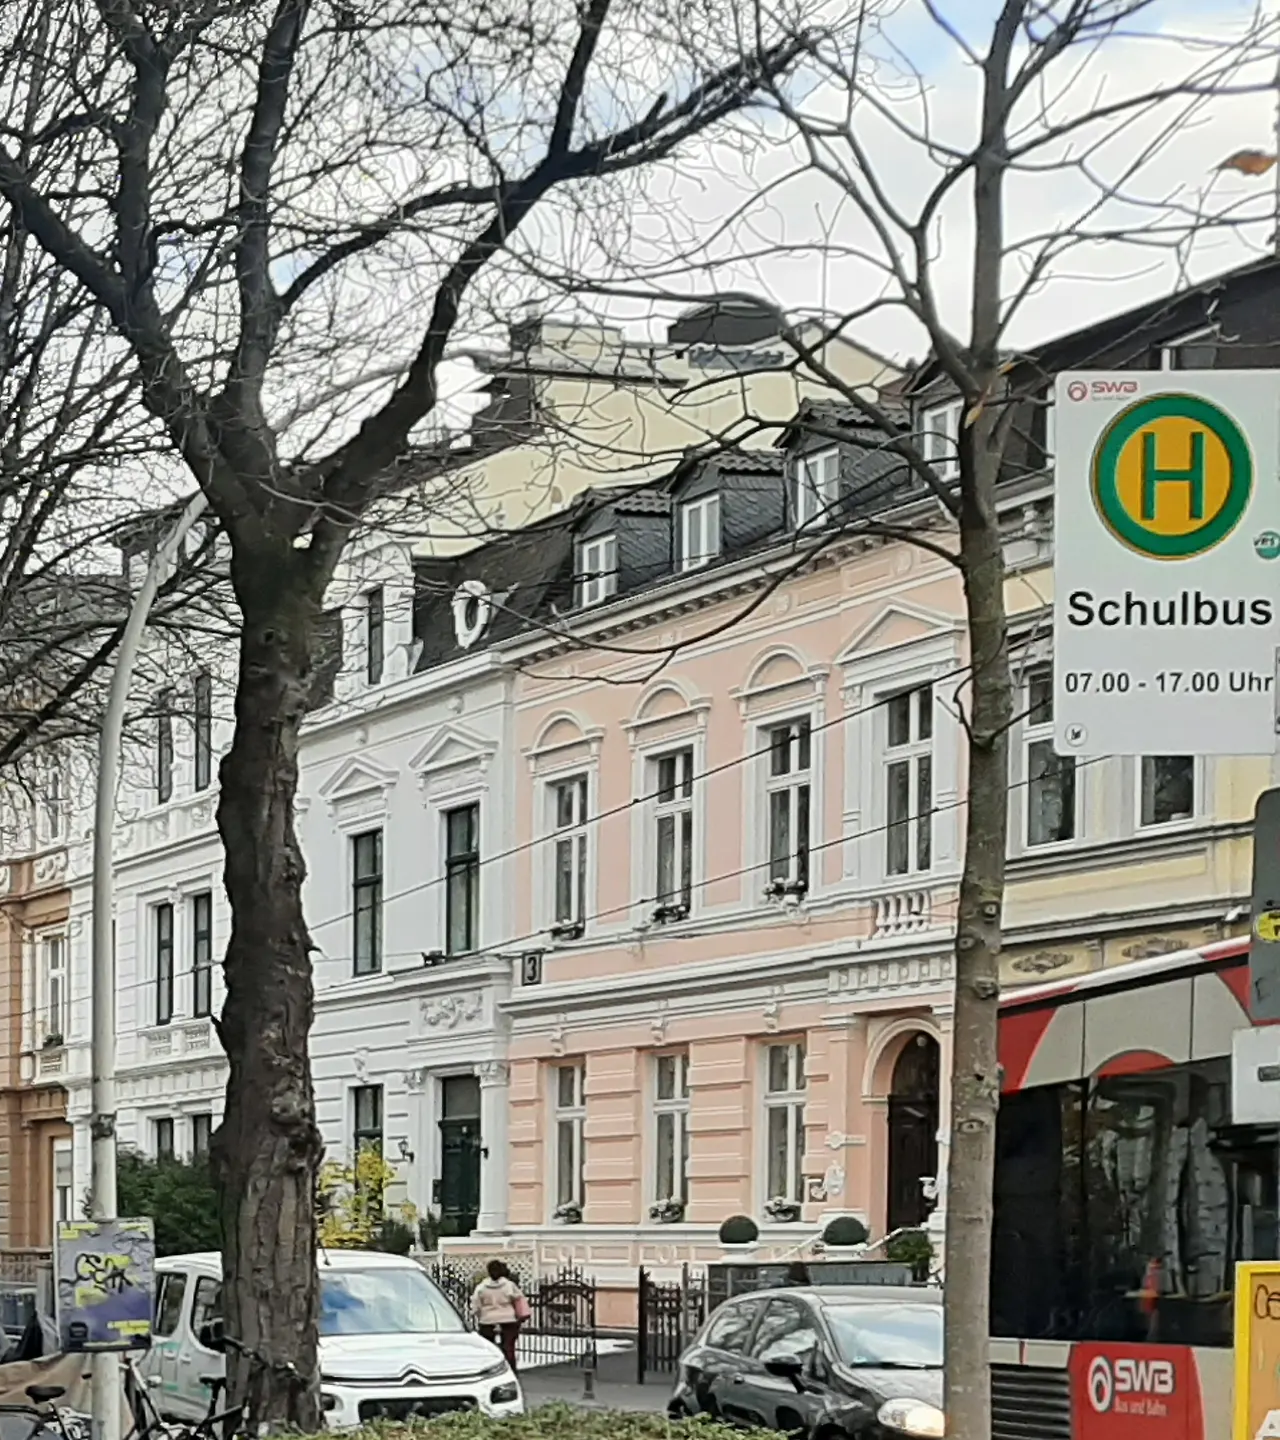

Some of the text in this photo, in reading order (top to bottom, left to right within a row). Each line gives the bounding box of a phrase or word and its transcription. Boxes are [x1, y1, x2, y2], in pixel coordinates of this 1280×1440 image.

[1091, 381, 1138, 393] SWB
[1140, 431, 1205, 521] H
[1067, 591, 1273, 626] Schulbus
[1065, 672, 1130, 693] 07.00
[1155, 671, 1220, 693] 17.00
[1229, 671, 1274, 693] Uhr
[1114, 1359, 1174, 1394] SWB
